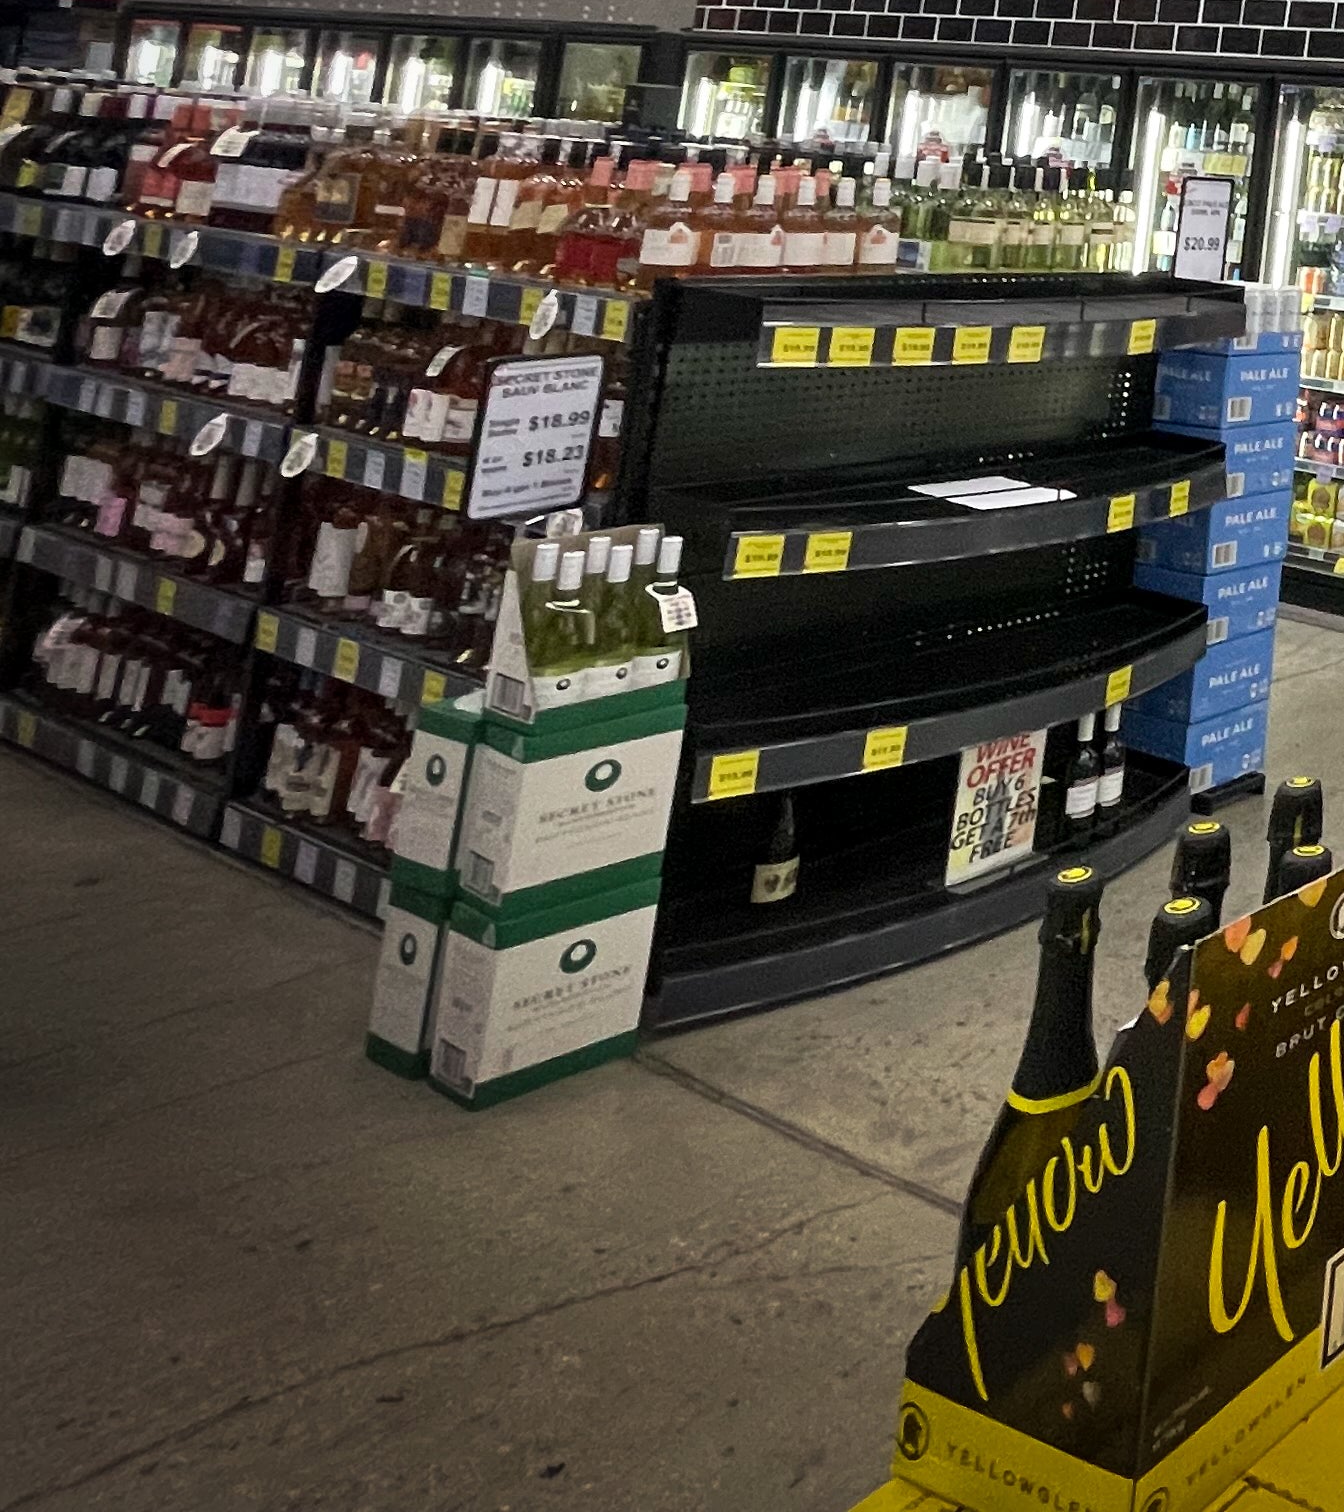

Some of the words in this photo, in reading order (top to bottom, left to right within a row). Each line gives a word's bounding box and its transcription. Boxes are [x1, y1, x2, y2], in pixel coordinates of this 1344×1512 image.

[1240, 369, 1267, 381] PALE
[1268, 367, 1290, 380] ALE
[528, 410, 591, 432] $18.99
[522, 445, 585, 468] $18.23
[1234, 440, 1262, 455] PALE
[1263, 436, 1284, 450] ALE
[1225, 511, 1254, 528] PALE
[1255, 506, 1278, 521] ALE
[1217, 581, 1246, 600] PALE
[1247, 575, 1270, 592] ALE
[1208, 670, 1238, 689] PALE
[1238, 662, 1261, 679] ALE
[1202, 727, 1231, 748] PALE
[1231, 717, 1255, 736] ALE
[976, 734, 1031, 764] WINE
[966, 747, 1037, 789] OFFER
[1014, 773, 1027, 791] 6
[1275, 1015, 1327, 1059] BRUT
